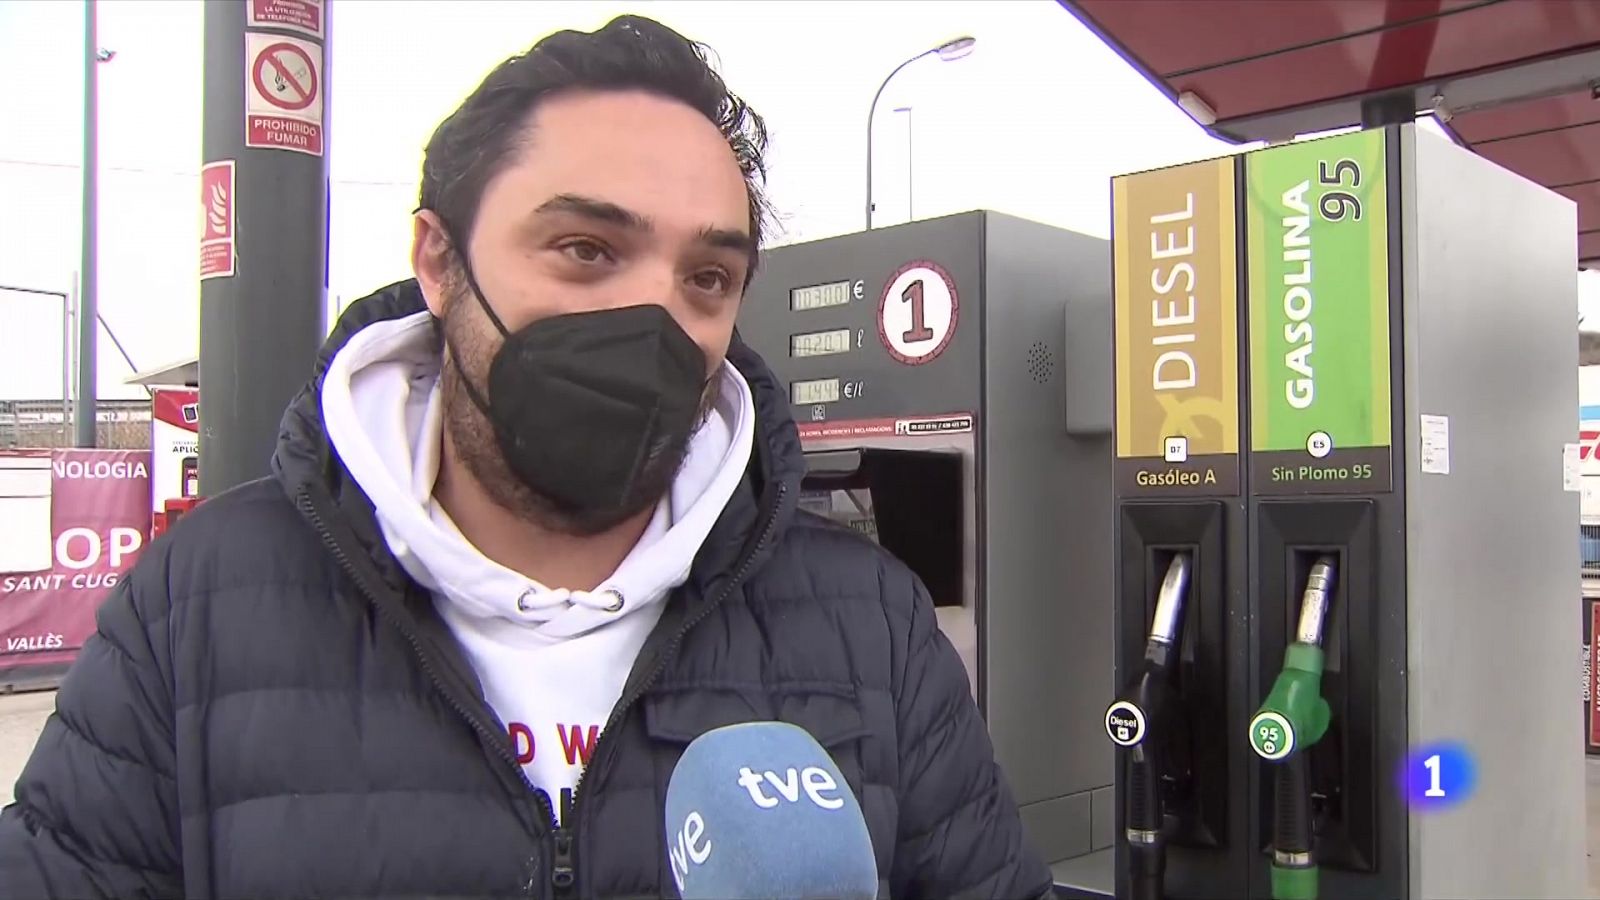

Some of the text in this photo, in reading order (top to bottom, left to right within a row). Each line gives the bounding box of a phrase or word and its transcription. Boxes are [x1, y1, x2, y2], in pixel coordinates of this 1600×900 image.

[254, 119, 317, 136] PROHIBIDO
[267, 131, 307, 147] FUMAR
[1318, 157, 1363, 223] 95
[1150, 192, 1197, 391] DIESEL
[1281, 179, 1314, 410] GASOLINA
[901, 279, 934, 344] 1
[53, 461, 148, 479] NOLOGIA
[1136, 469, 1217, 486] Gasóleo A
[1272, 464, 1372, 481] Sin Plomo 95
[55, 527, 142, 569] OP
[2, 573, 118, 592] SANT CUG
[7, 632, 64, 650] VALLÈS
[1110, 714, 1137, 729] Diesel
[1259, 726, 1279, 741] 95
[738, 766, 844, 809] tve
